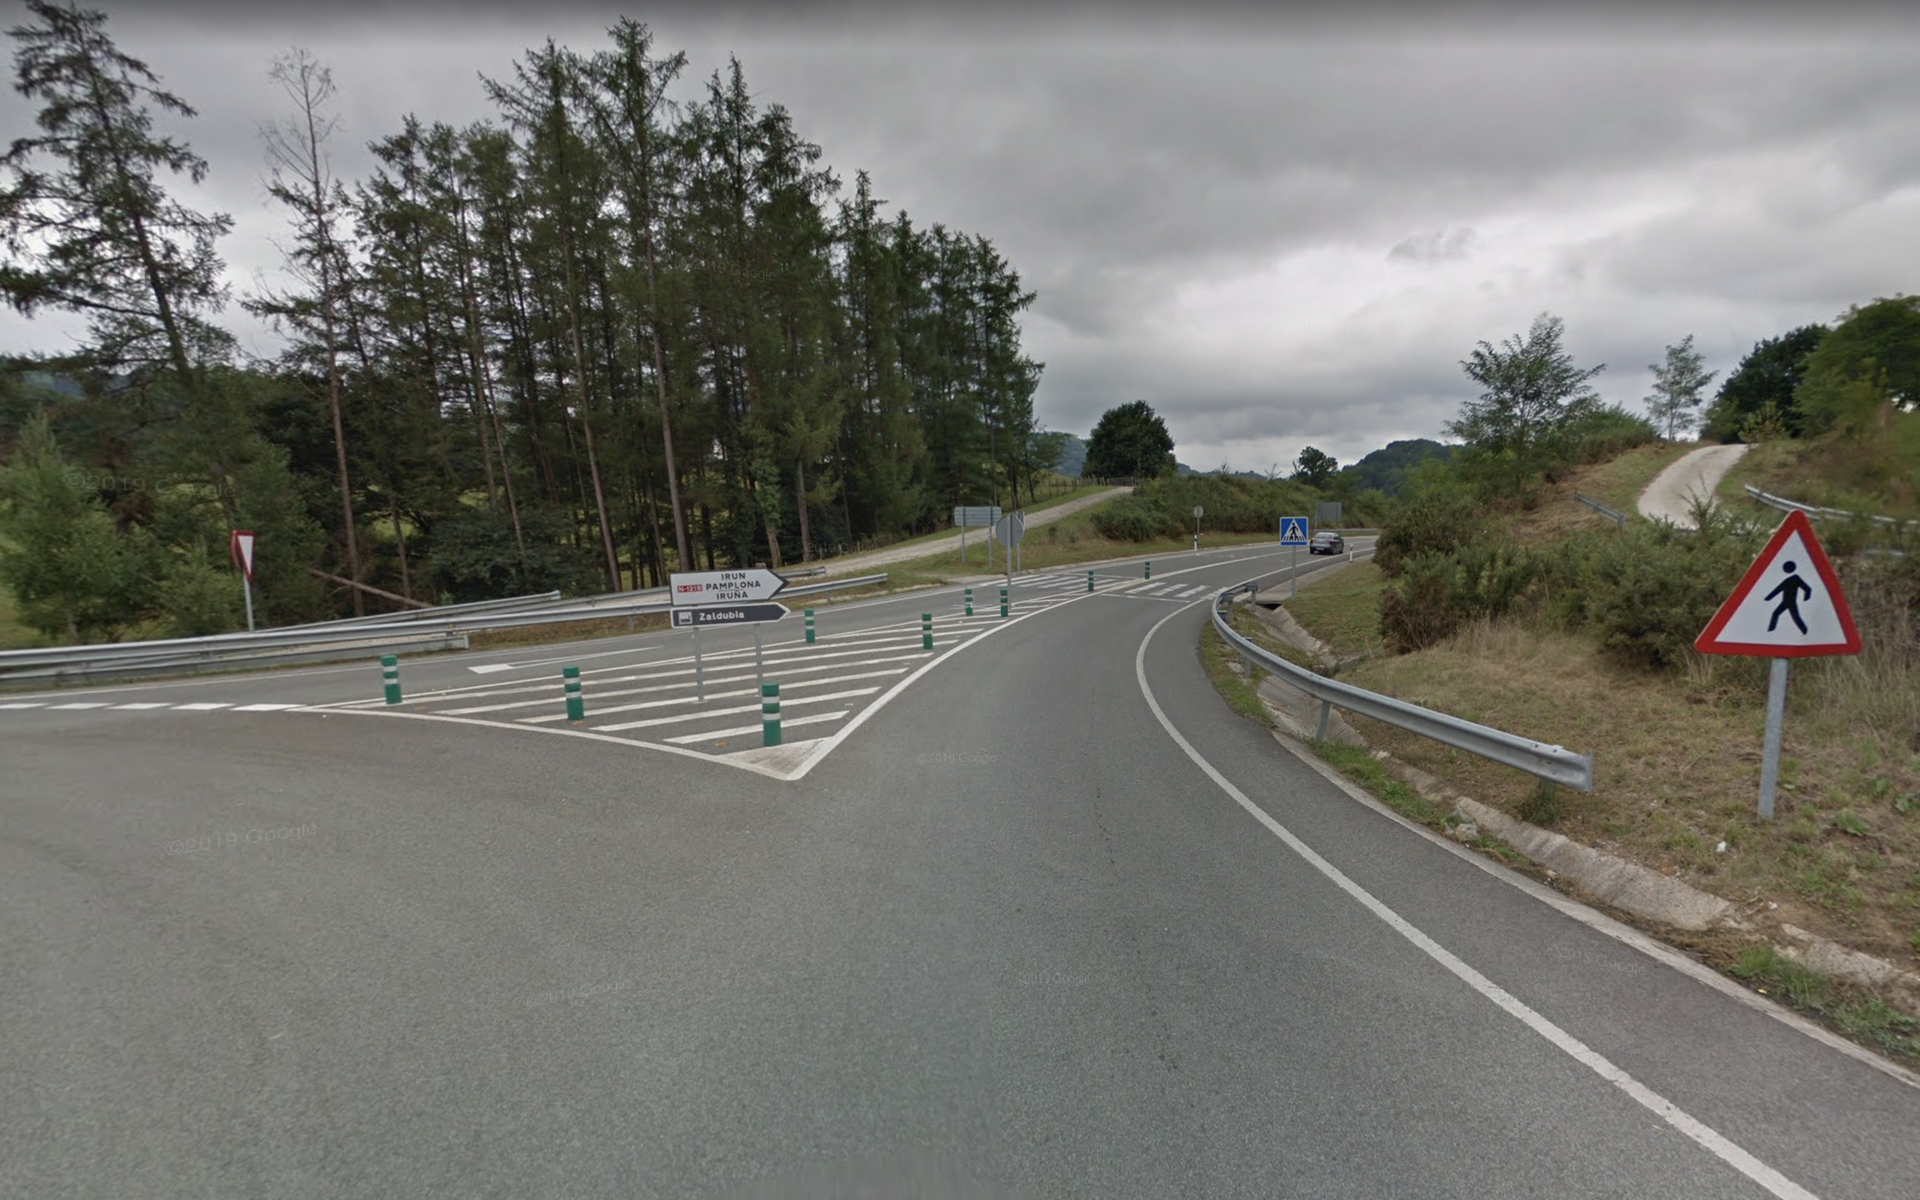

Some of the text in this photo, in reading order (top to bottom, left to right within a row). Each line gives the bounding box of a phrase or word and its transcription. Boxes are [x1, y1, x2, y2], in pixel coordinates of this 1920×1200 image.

[721, 572, 746, 581] IRUN
[706, 580, 761, 591] PAMPLONA
[716, 590, 749, 600] IRUÑA
[699, 611, 745, 621] Zaldubia
